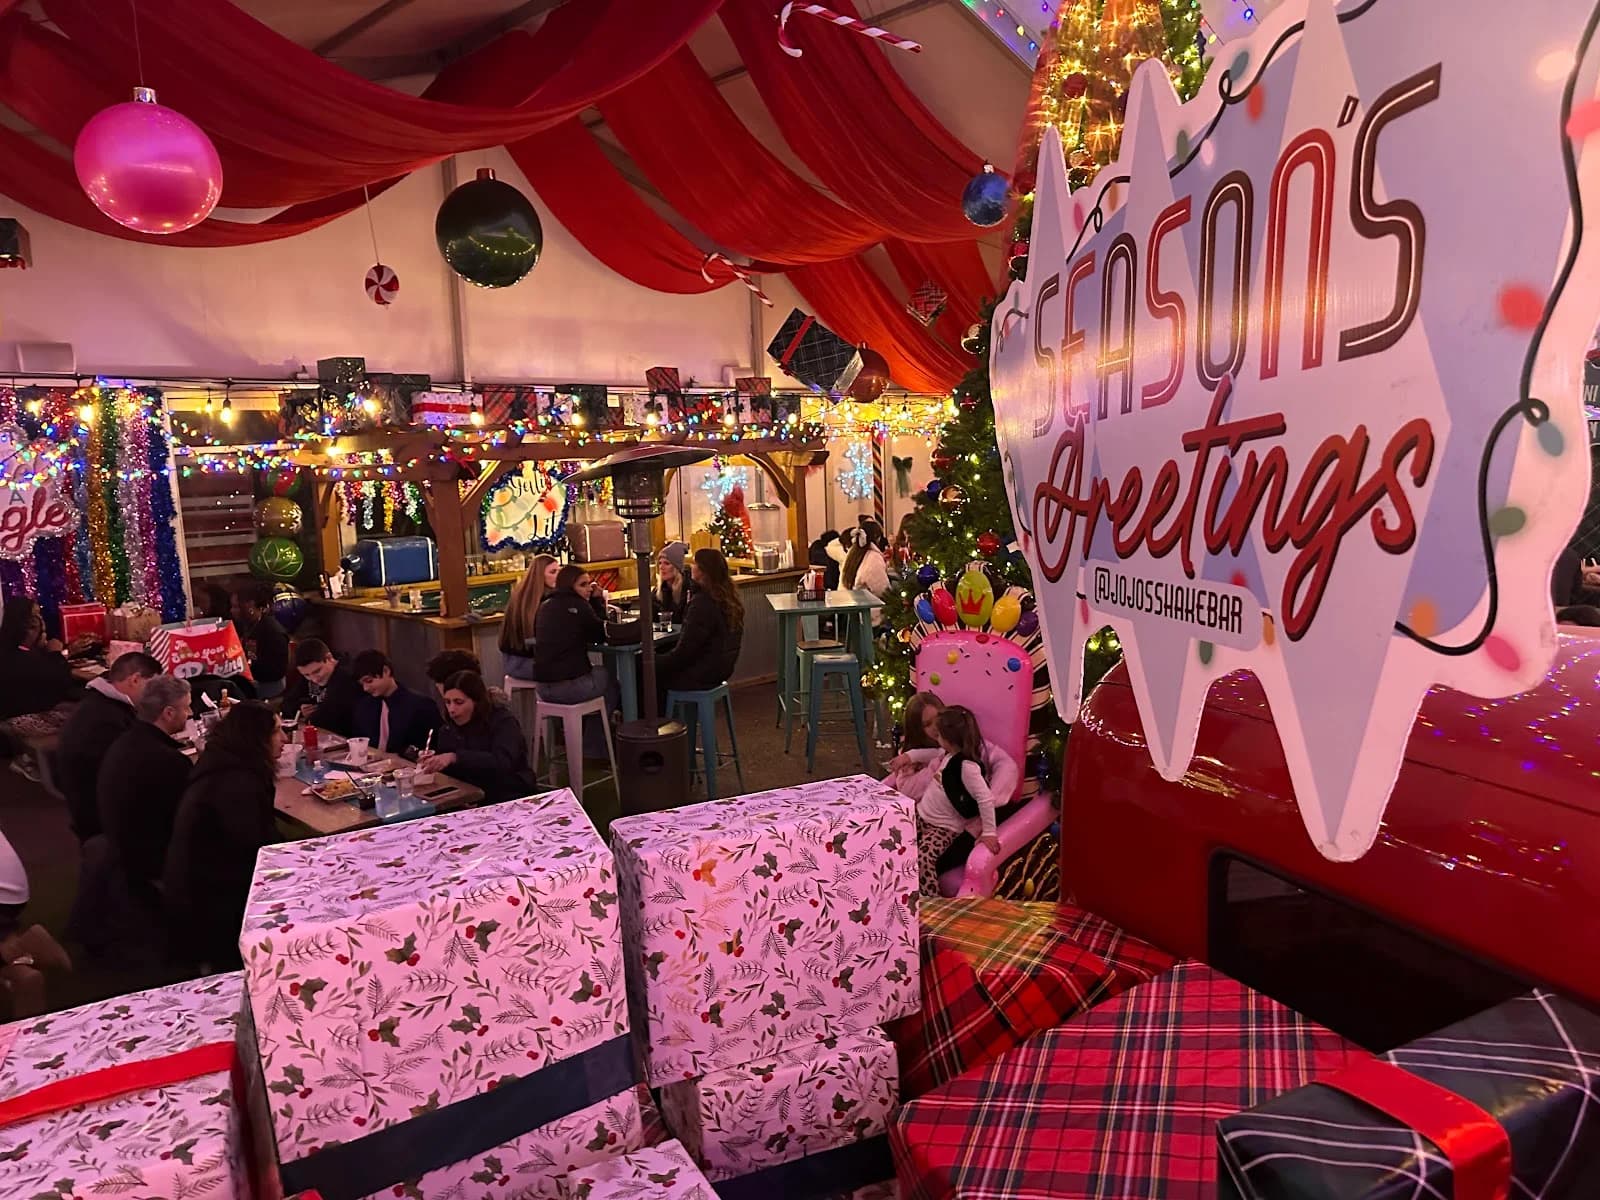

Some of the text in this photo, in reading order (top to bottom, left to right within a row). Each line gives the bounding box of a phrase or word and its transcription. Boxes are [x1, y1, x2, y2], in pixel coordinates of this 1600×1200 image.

[1033, 62, 1442, 438] SEASON'S
[1033, 373, 1435, 642] Greetings
[1094, 566, 1243, 634] @JOJOSSHAKEBAR
